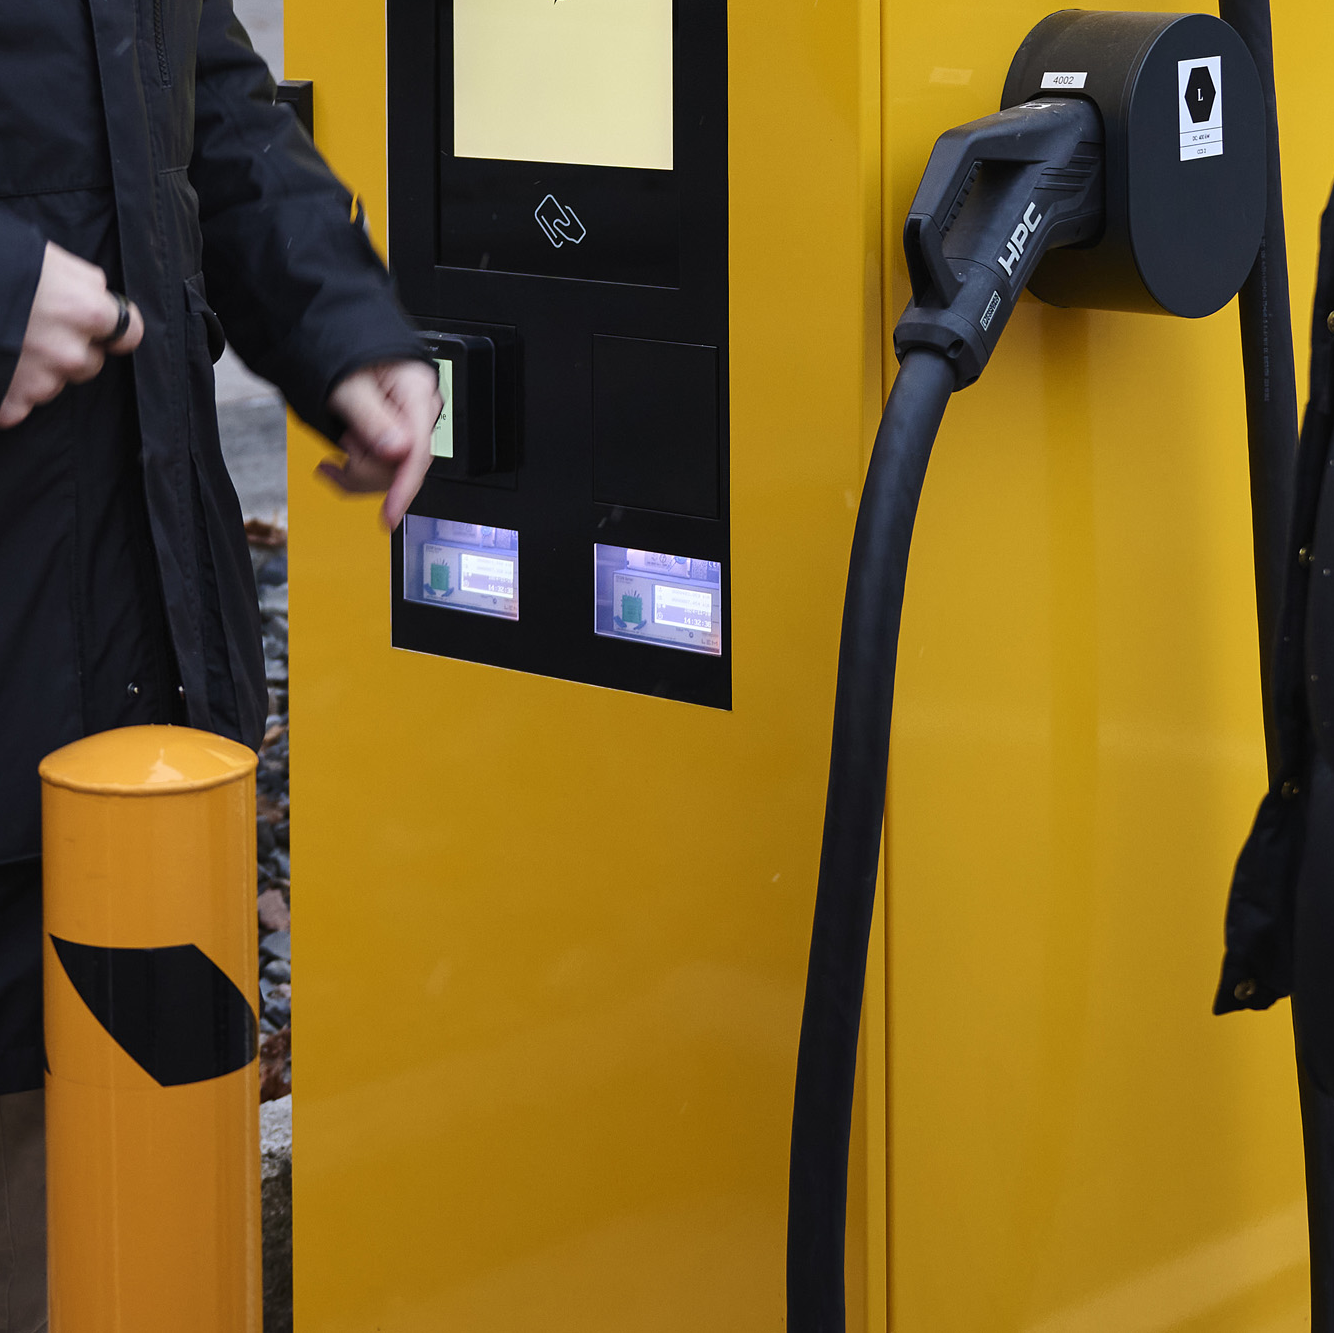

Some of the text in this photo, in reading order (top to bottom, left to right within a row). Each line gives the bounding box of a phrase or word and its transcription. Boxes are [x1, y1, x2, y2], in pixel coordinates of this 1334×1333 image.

[1053, 75, 1075, 85] 4002
[1197, 88, 1203, 101] L
[997, 201, 1043, 277] HPC
